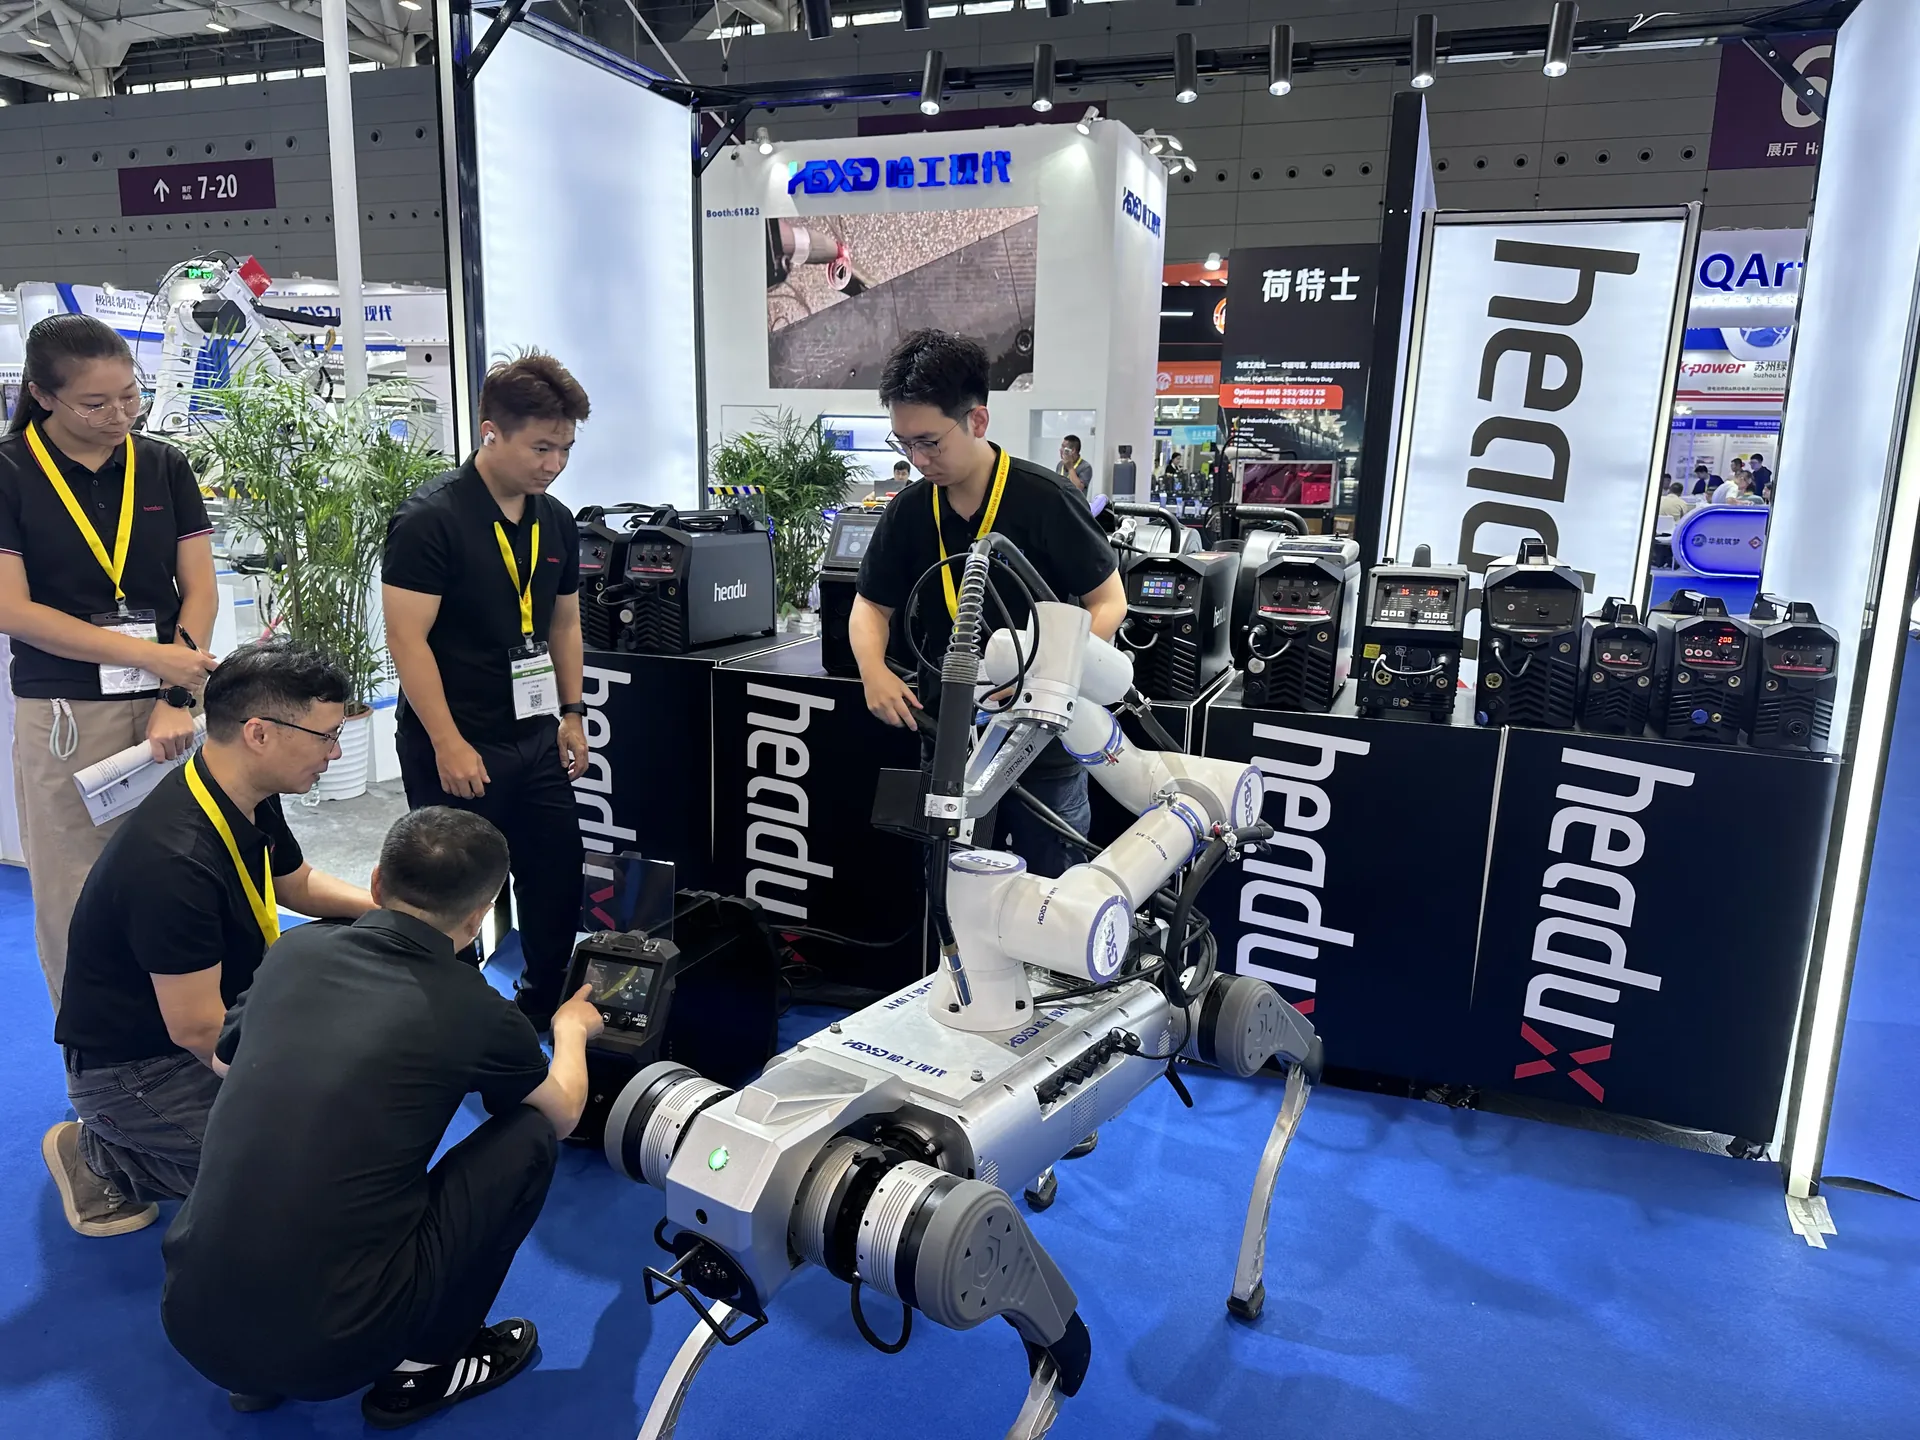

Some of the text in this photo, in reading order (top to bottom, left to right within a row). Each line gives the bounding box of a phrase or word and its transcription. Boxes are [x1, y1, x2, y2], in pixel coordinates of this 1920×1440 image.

[1766, 142, 1798, 157] 展厅
[886, 150, 1012, 190] 哈工现代
[197, 174, 238, 200] 7-20
[705, 207, 760, 219] Booth:61823
[1262, 267, 1360, 303] 荷特士
[1699, 252, 1803, 292] QAr
[1234, 388, 1265, 397] Optimus
[1281, 388, 1314, 397] 353/503
[1314, 388, 1326, 396] XS
[1252, 376, 1264, 384] High
[1305, 376, 1320, 384] Heavy
[1321, 376, 1334, 384] Duty
[1280, 397, 1313, 406] 353/503
[1457, 239, 1640, 690] head
[746, 682, 835, 962] headu
[1235, 722, 1371, 1014] headu
[1514, 747, 1695, 1103] headux
[887, 1053, 948, 1078] 哈工现代
